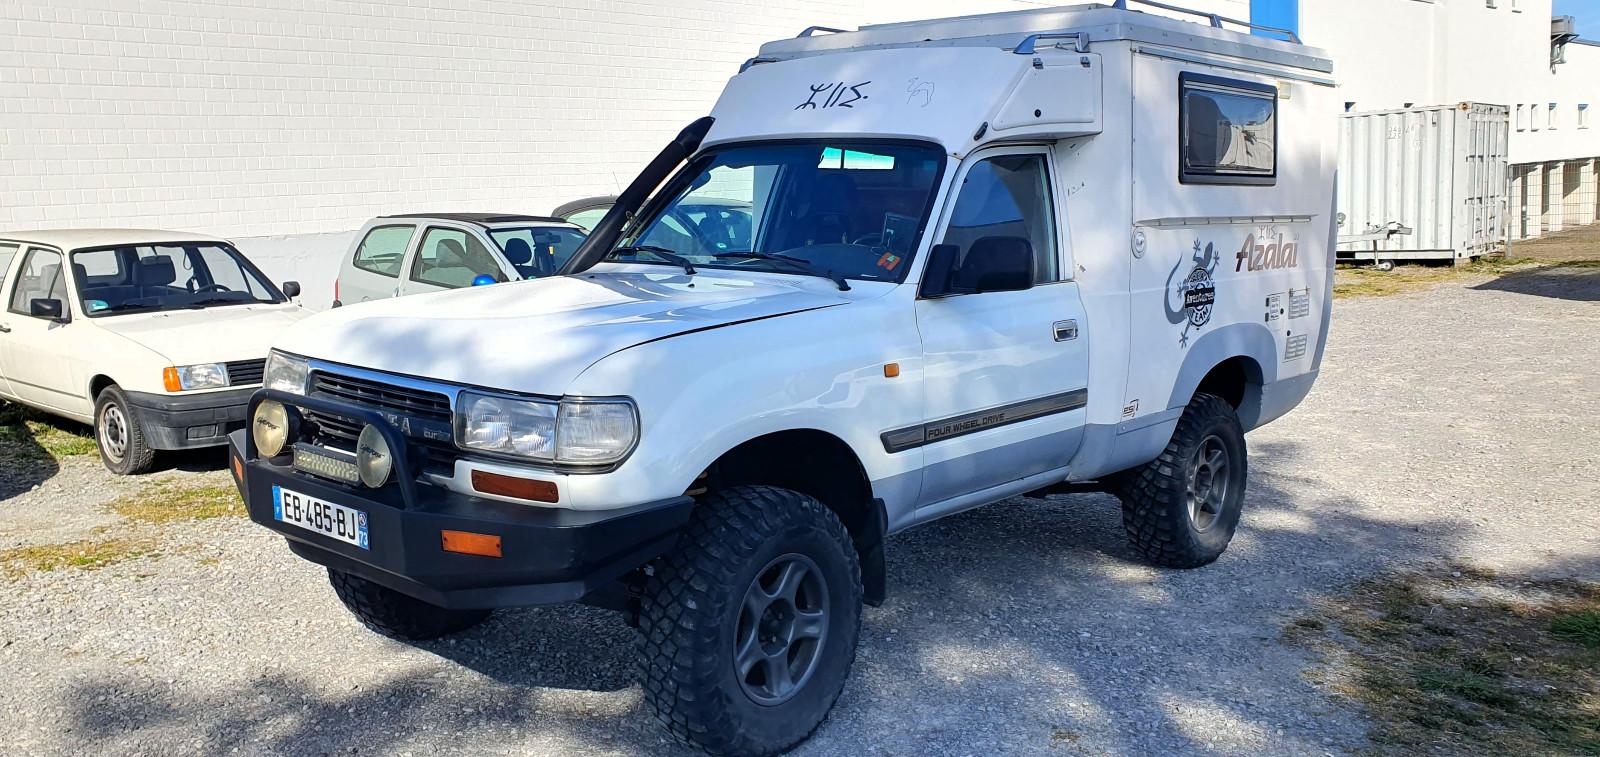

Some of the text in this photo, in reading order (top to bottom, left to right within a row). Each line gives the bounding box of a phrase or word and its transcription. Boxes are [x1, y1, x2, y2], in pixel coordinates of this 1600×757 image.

[928, 413, 1004, 438] FOUR WHEEL DRIVE
[359, 531, 368, 545] 73
